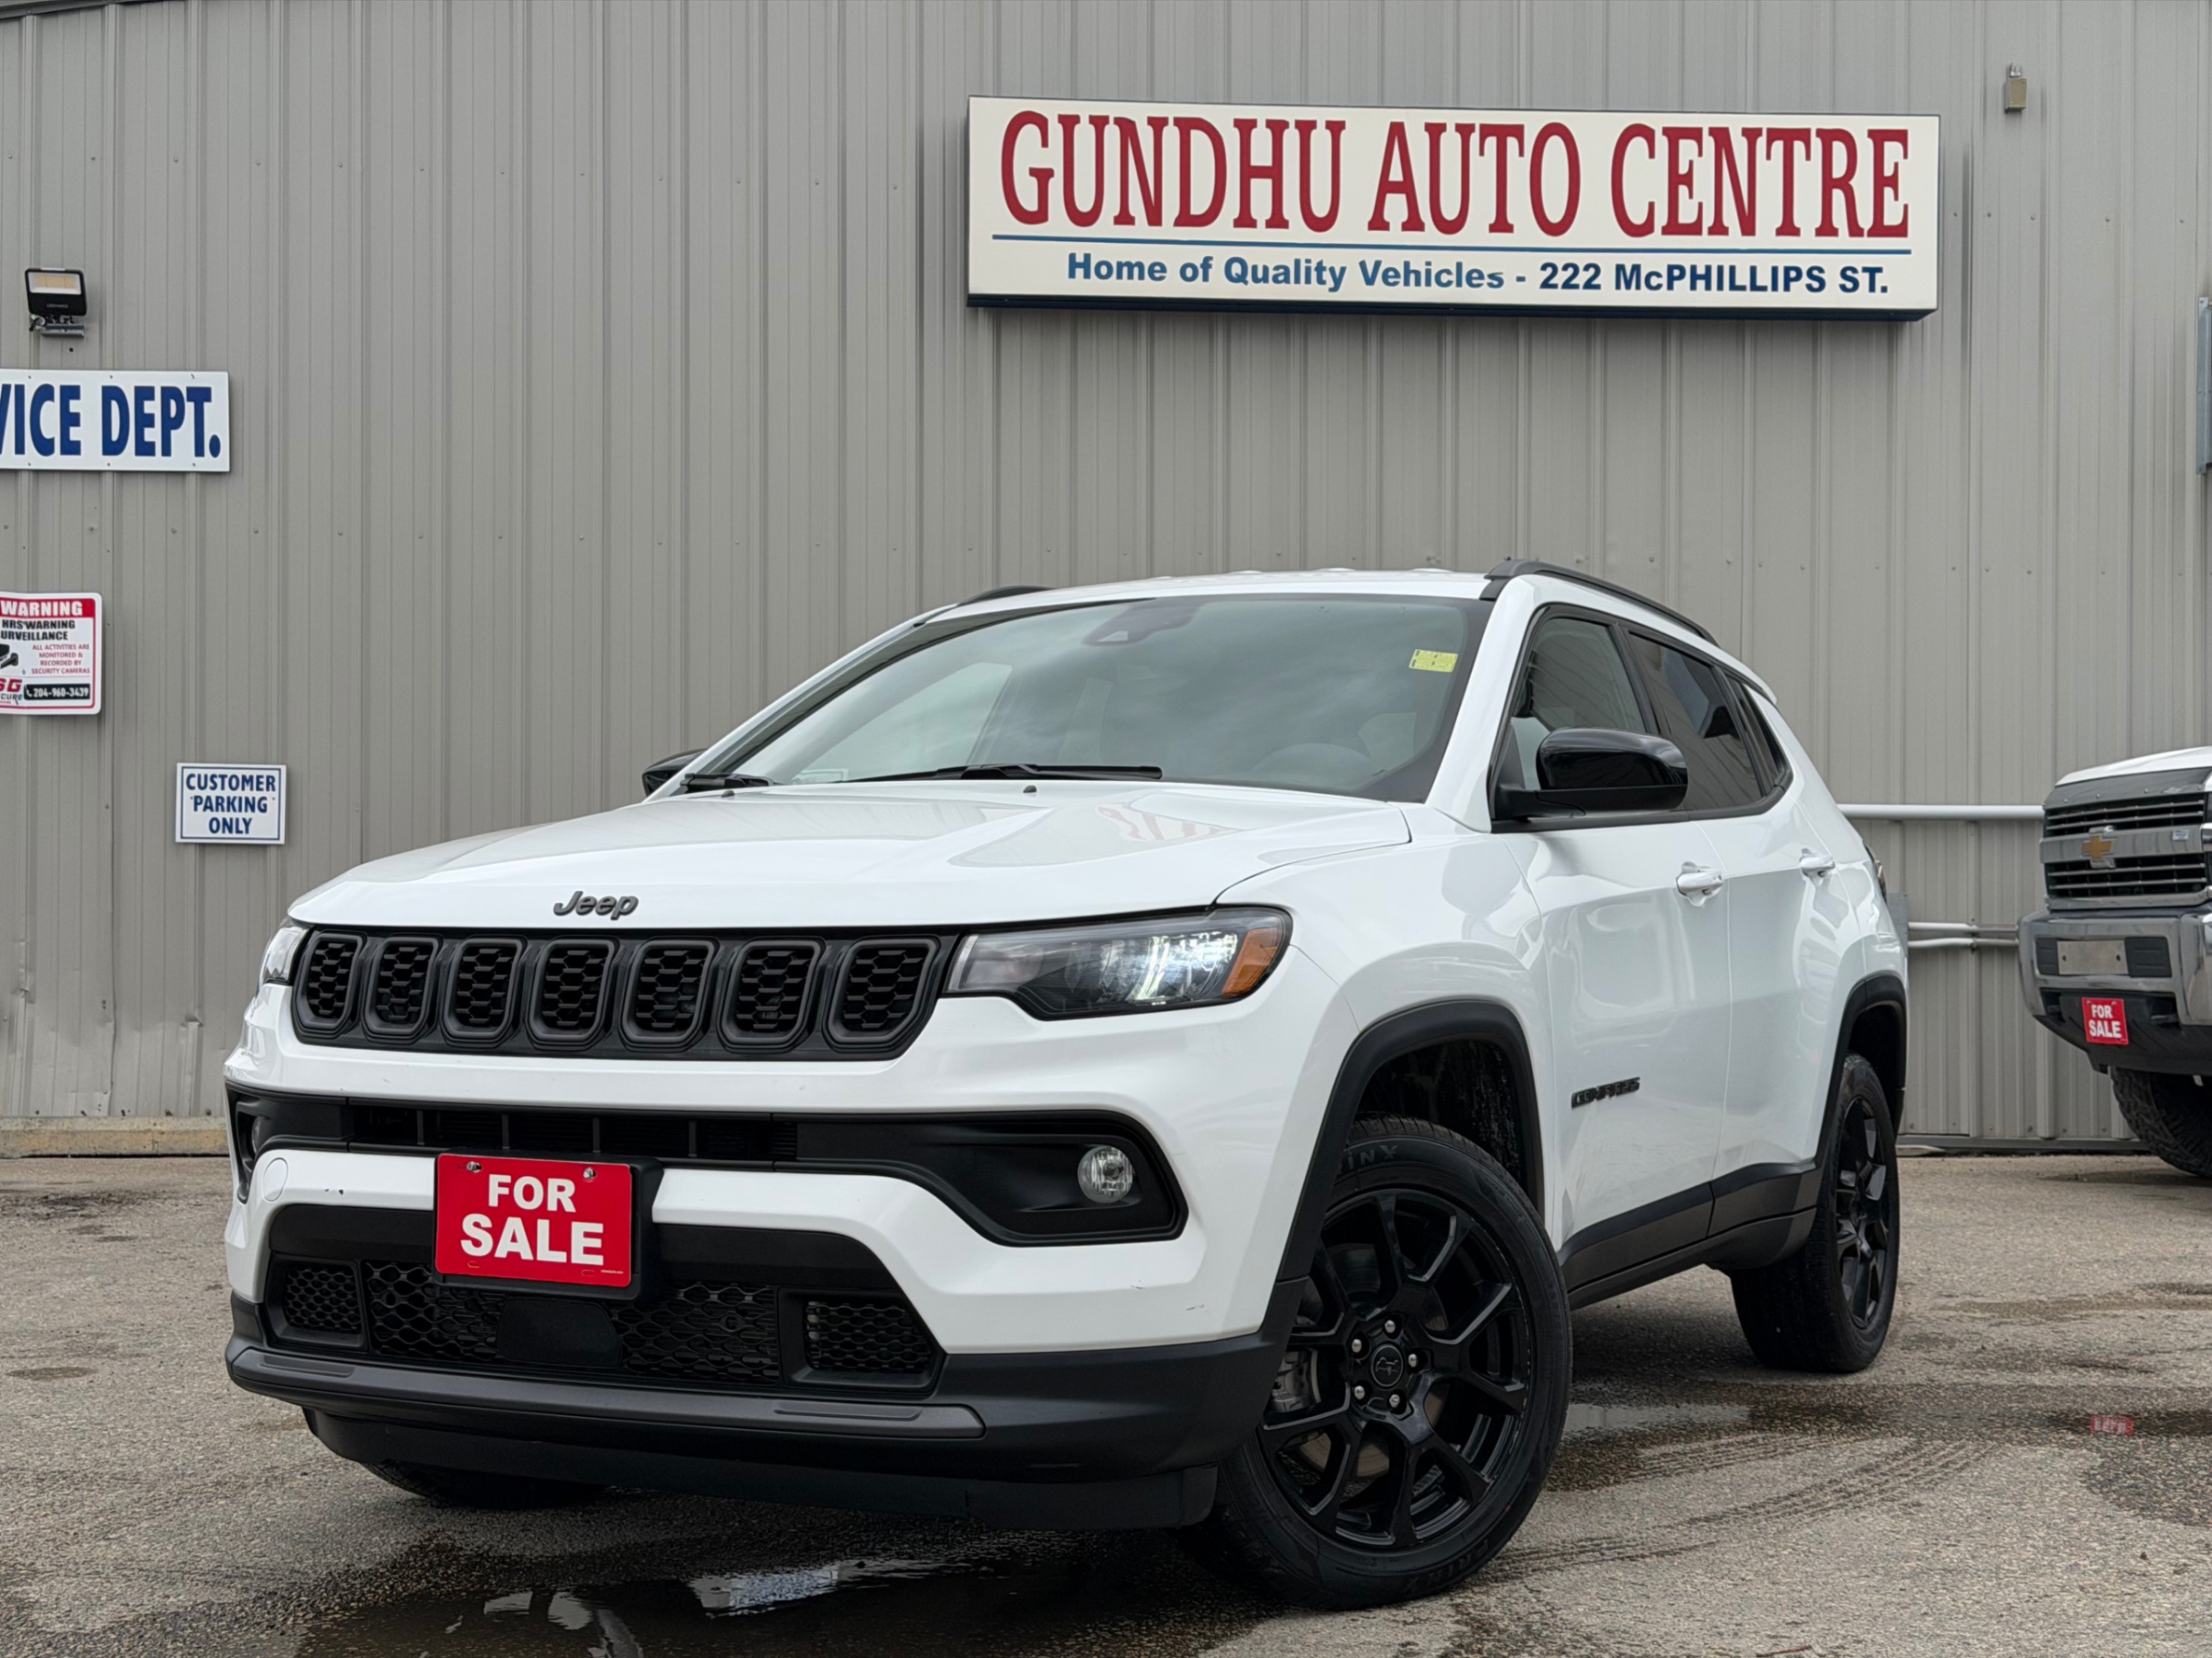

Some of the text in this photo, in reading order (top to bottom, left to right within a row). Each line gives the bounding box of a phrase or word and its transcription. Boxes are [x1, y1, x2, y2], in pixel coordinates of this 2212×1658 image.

[1001, 111, 1908, 238] GUNDHU AUTO CENTRE
[1068, 252, 1167, 282] Home
[1179, 255, 1214, 282] of
[1224, 256, 1347, 293] Quality
[1358, 260, 1504, 289] Vehicles
[1539, 262, 1601, 291] 222
[1615, 264, 1826, 293] McPHILLIPS
[1839, 266, 1888, 294] ST.
[102, 385, 221, 458] DEPT.
[0, 600, 83, 617] WARNING
[34, 687, 89, 698] 204-960-3439
[186, 774, 276, 792] CUSTOMER
[193, 795, 267, 813] PARKING
[208, 817, 252, 834] ONLY
[553, 891, 639, 921] Jeep
[2092, 1005, 2113, 1019] FOR
[2089, 1019, 2122, 1038] SALE
[488, 1174, 576, 1213] FOR
[460, 1213, 603, 1266] SALE
